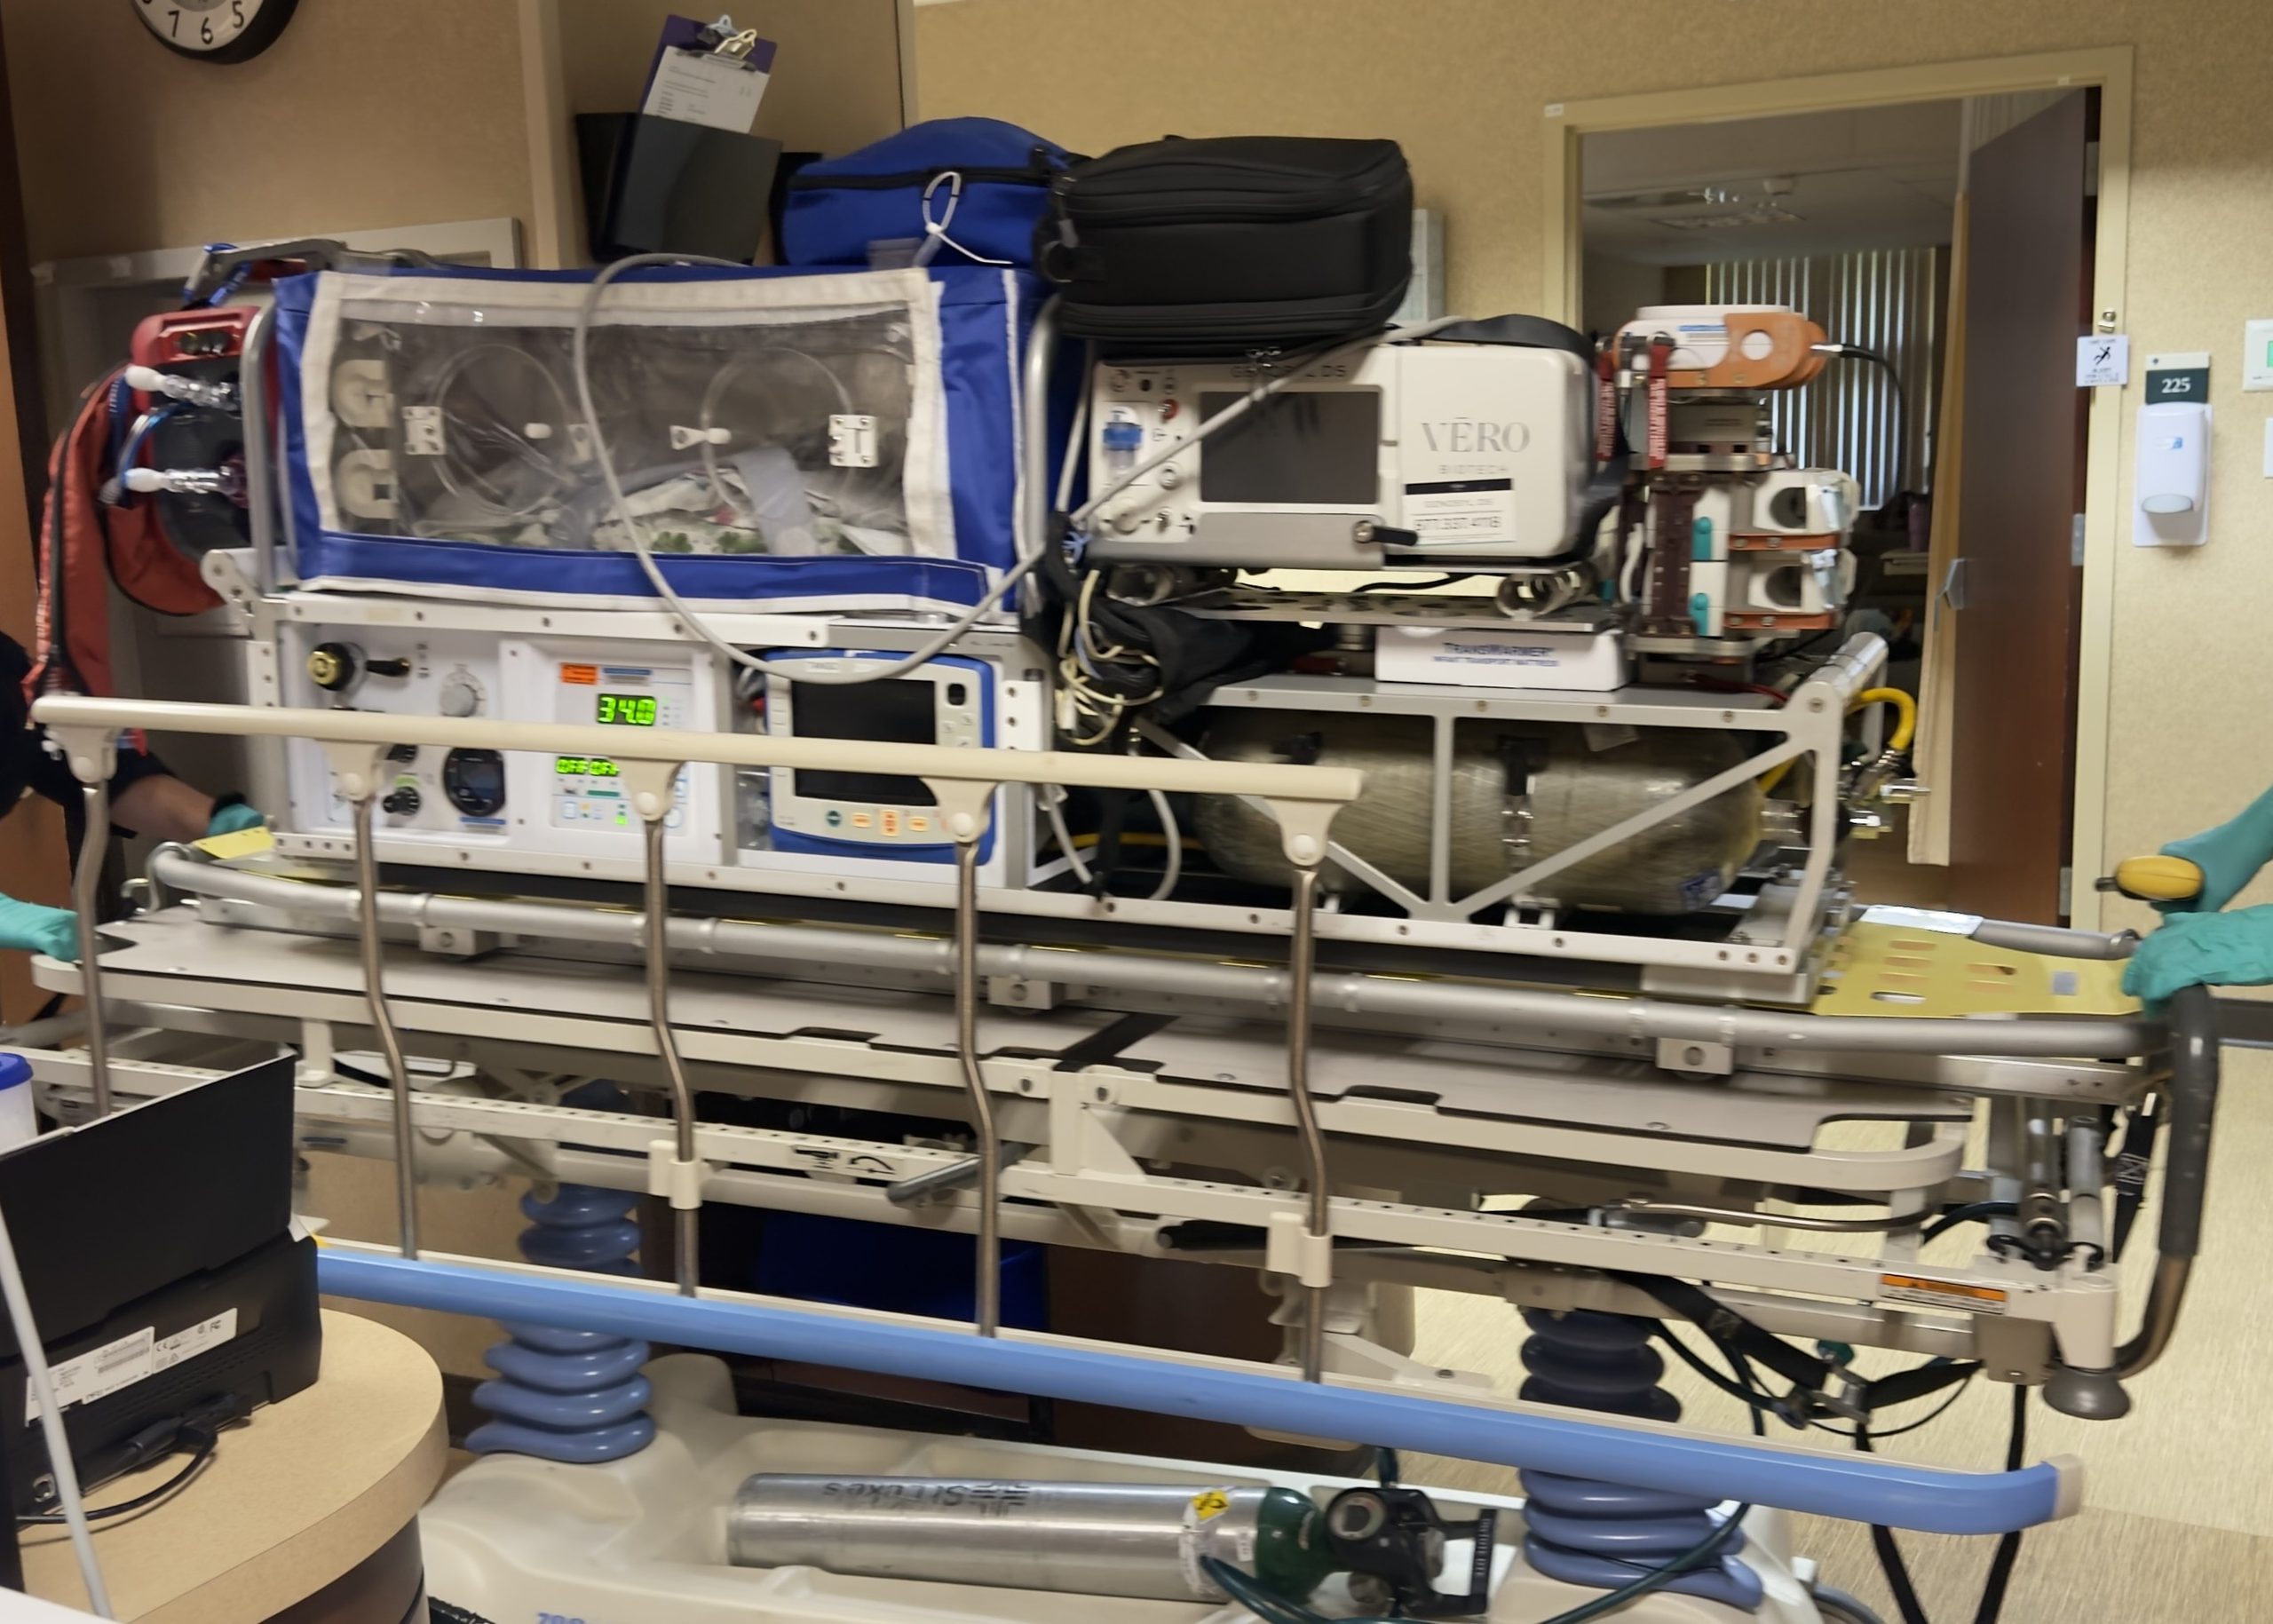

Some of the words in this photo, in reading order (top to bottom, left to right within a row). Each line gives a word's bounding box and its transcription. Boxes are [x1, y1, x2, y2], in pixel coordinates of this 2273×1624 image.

[167, 10, 179, 37] 7
[232, 1, 245, 28] 5
[201, 17, 213, 44] 6
[2161, 376, 2191, 394] 225
